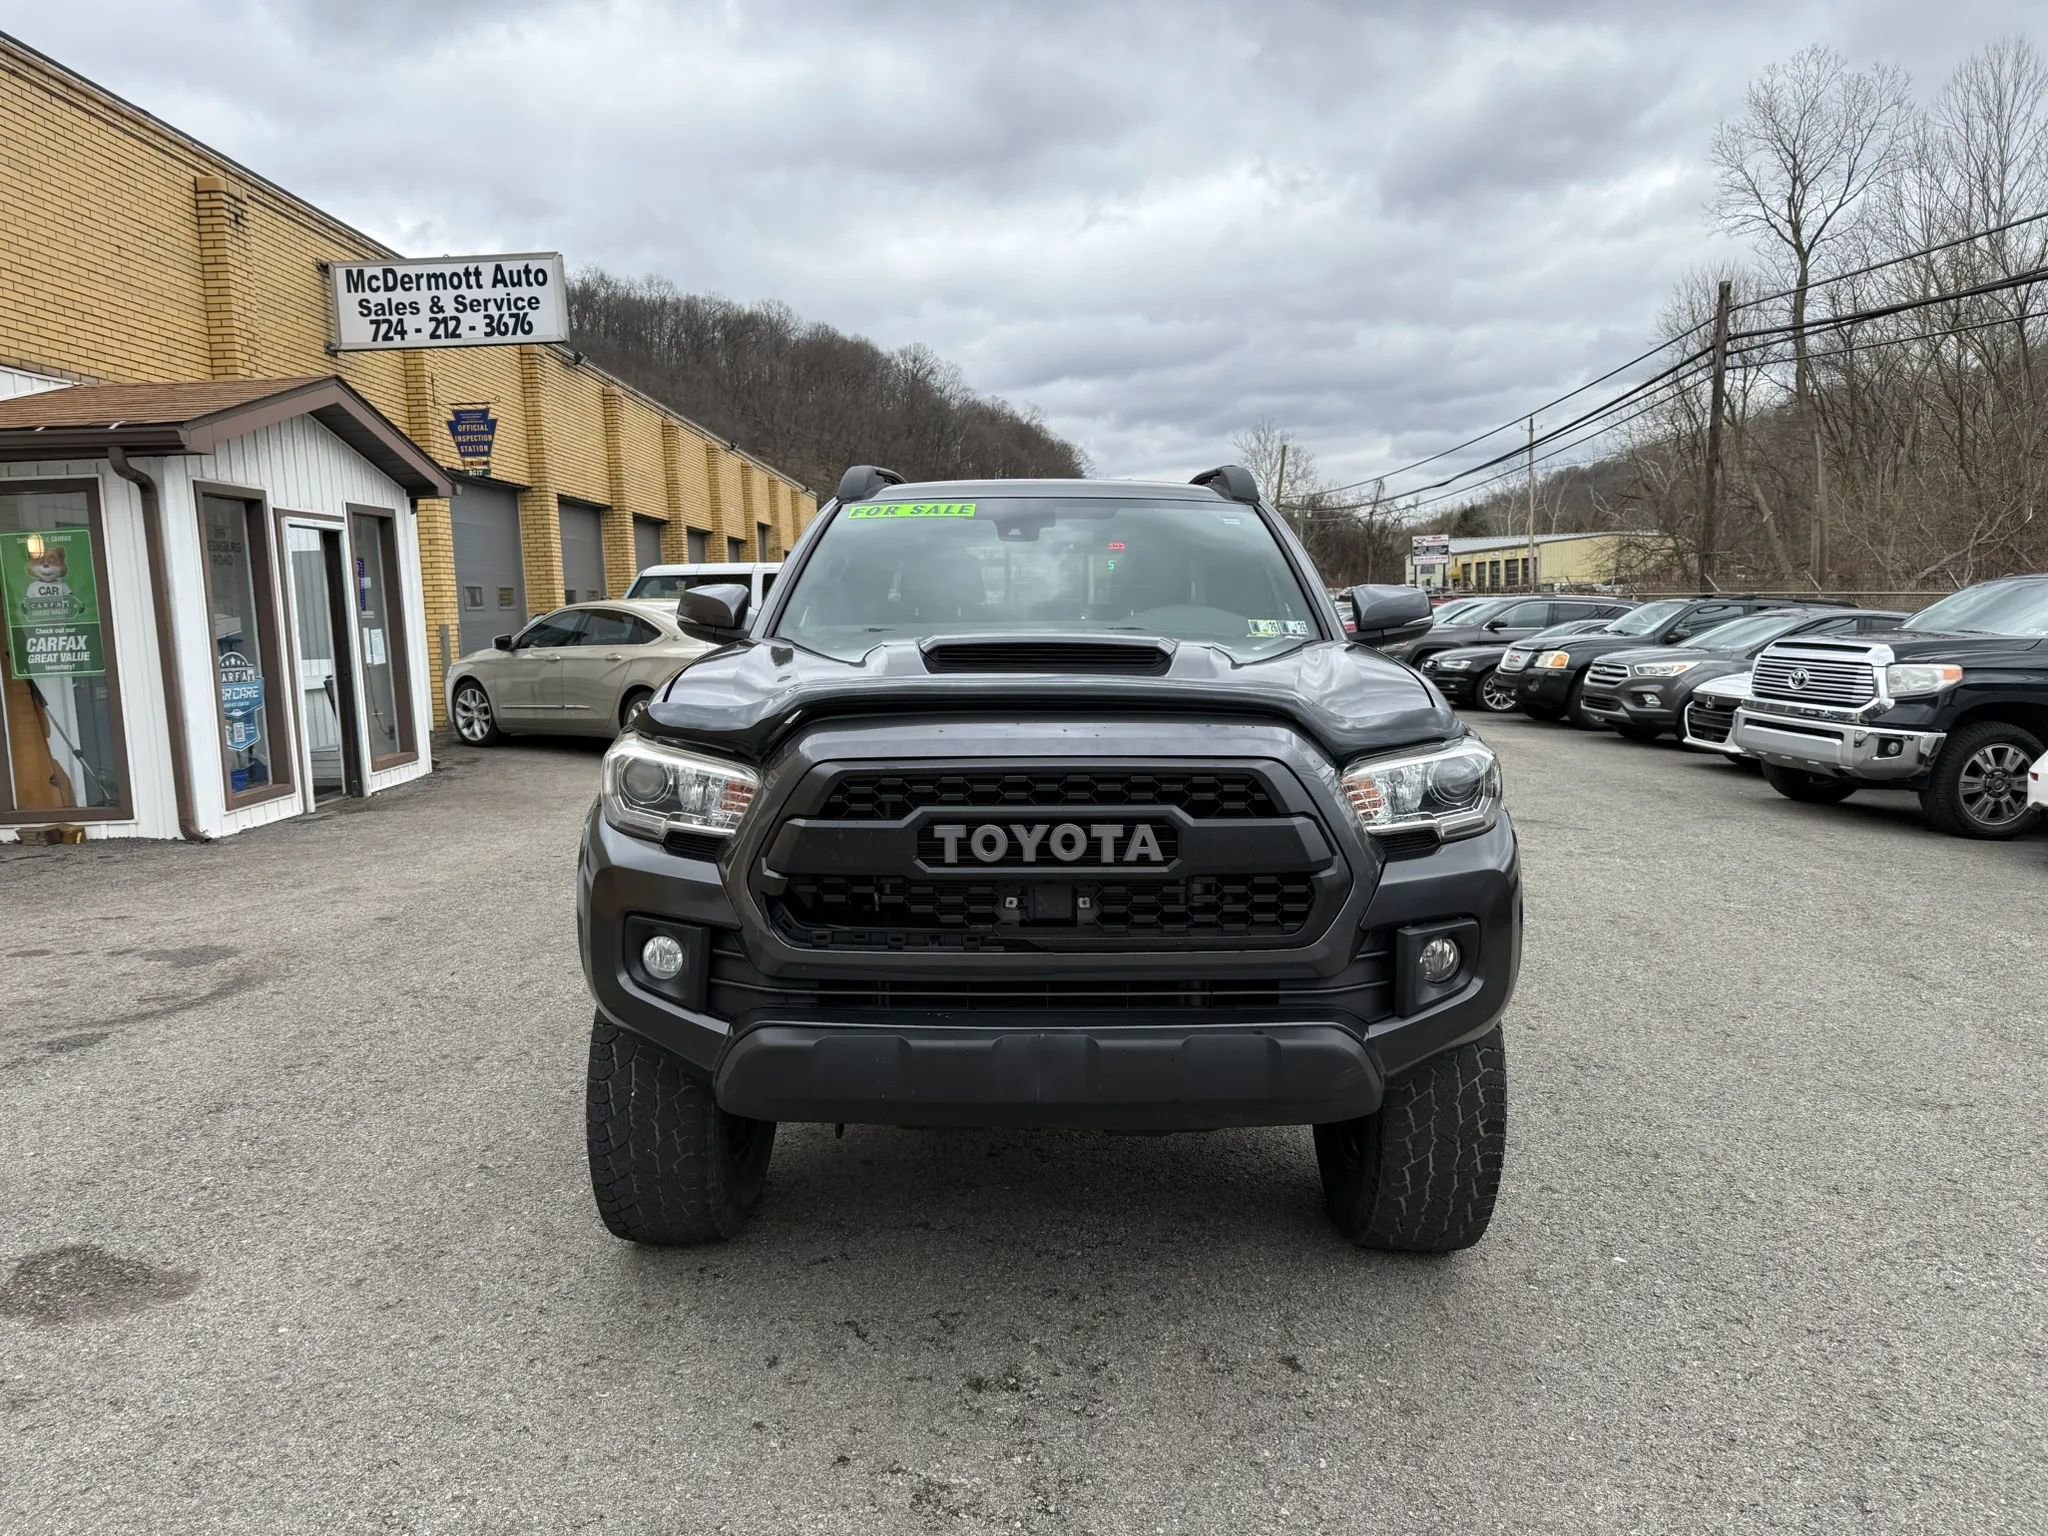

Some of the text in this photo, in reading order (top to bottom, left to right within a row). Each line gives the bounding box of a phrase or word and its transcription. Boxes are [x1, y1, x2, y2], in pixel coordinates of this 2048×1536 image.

[346, 262, 548, 293] McDermott Auto
[358, 292, 541, 318] Sales & Service
[369, 318, 408, 342] 724
[429, 316, 462, 340] 212
[483, 312, 533, 337] 3676
[457, 424, 489, 432] OFFICIAL
[454, 434, 493, 442] INSPECTION
[460, 445, 489, 453] STATION
[850, 504, 975, 517] FOR SALE
[38, 586, 60, 596] CAR
[27, 636, 87, 652] CARFAX
[28, 652, 90, 664] GREAT VALUE
[232, 686, 260, 700] CARE
[934, 824, 1164, 863] TOYOTA
